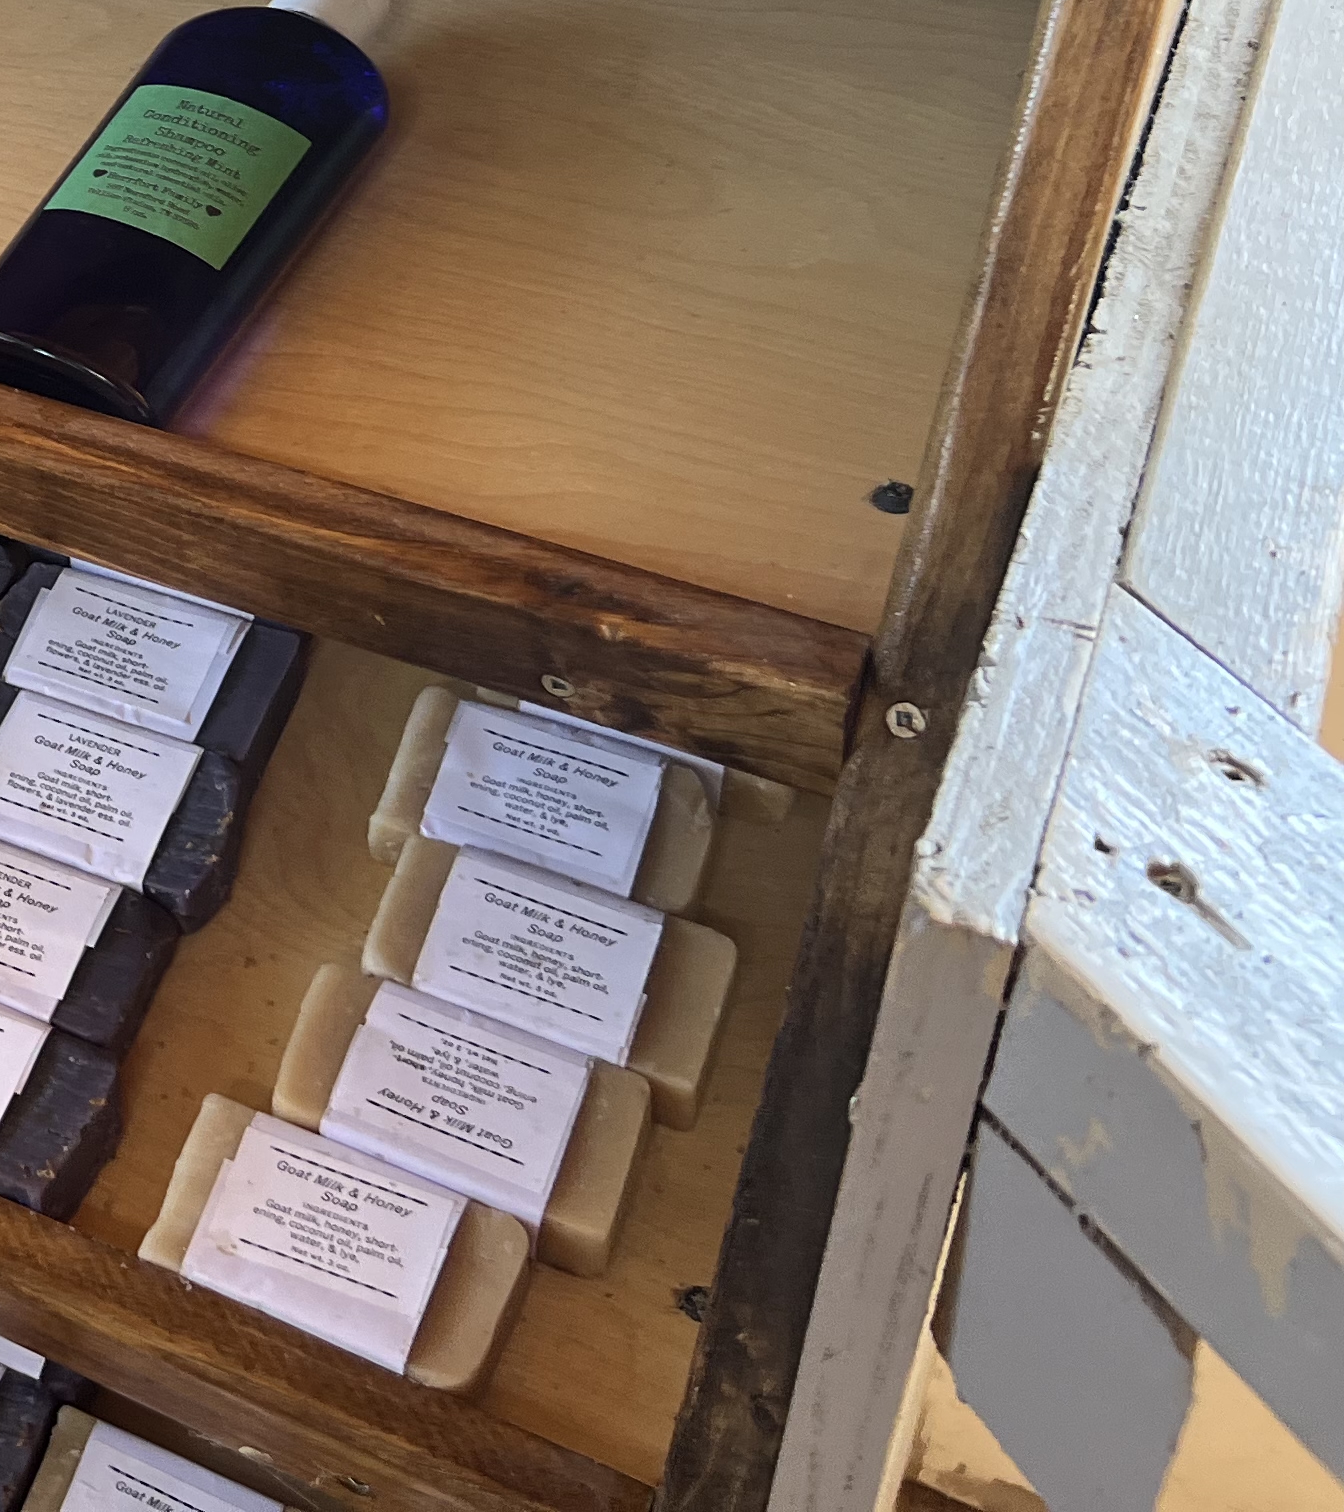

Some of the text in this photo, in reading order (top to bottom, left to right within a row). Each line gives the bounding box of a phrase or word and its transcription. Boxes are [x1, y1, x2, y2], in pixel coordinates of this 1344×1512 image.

[177, 100, 246, 130] Natural
[143, 109, 262, 157] Conditioning
[154, 126, 227, 157] Shampoo
[205, 157, 241, 180] Mint
[69, 734, 121, 757] LAVENDER
[34, 735, 147, 780] Goat Milk & Honey
[69, 759, 101, 776] Soap
[4, 888, 13, 897] &
[17, 892, 58, 913] Honey
[484, 892, 618, 947] Goat Milk & Honey
[5, 934, 30, 948] palm
[527, 923, 564, 943] Soap
[377, 1088, 426, 1114] Honey
[431, 1094, 469, 1115] Soap
[443, 1115, 475, 1134] Milk
[477, 1128, 513, 1149] Goat
[277, 1160, 412, 1218] Goat Milk & Honey
[321, 1191, 359, 1212] Soap
